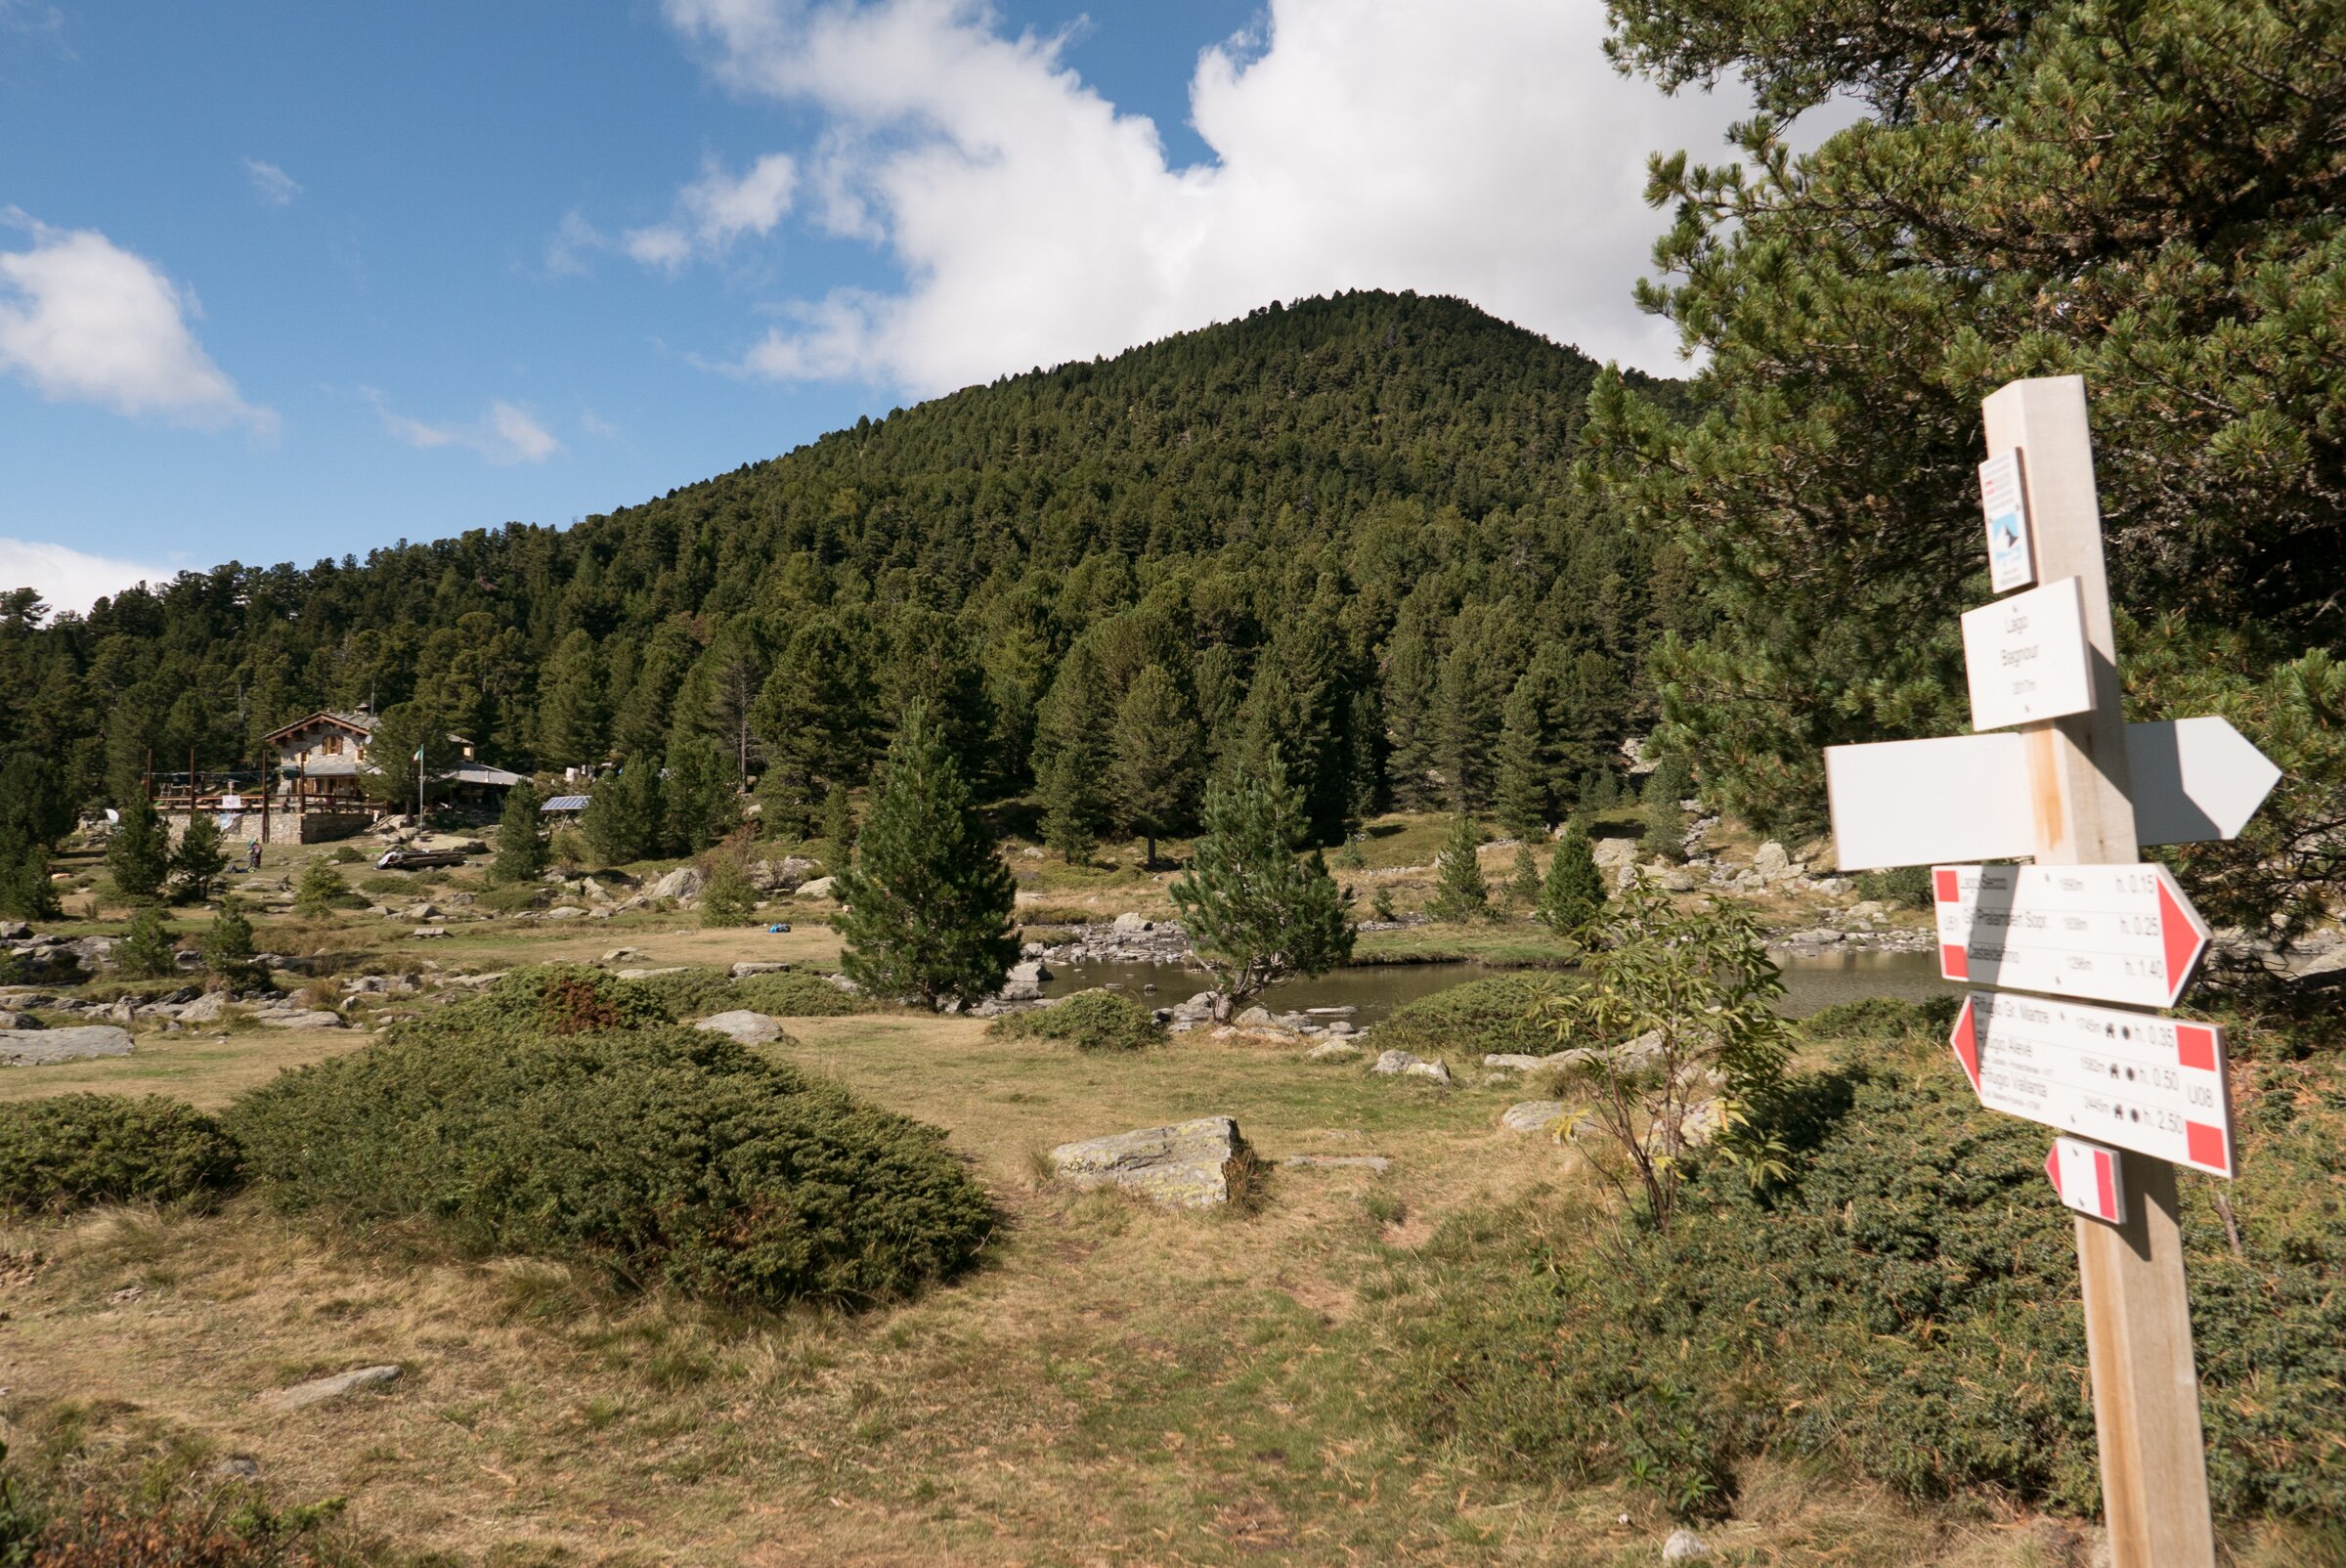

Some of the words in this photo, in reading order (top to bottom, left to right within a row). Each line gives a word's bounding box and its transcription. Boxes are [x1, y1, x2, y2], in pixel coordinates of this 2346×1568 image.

[2004, 616, 2027, 634] Lago
[2001, 645, 2039, 668] Bagnour
[2129, 874, 2155, 893] 0.15
[2134, 916, 2159, 936] 0.25
[2140, 959, 2163, 979] 1.40
[1973, 994, 2002, 1018] Rifugio
[2149, 1024, 2174, 1048] 0.35
[2152, 1067, 2179, 1091] 0.50
[1979, 1064, 2009, 1091] Rifugio
[2156, 1110, 2183, 1134] 2.50
